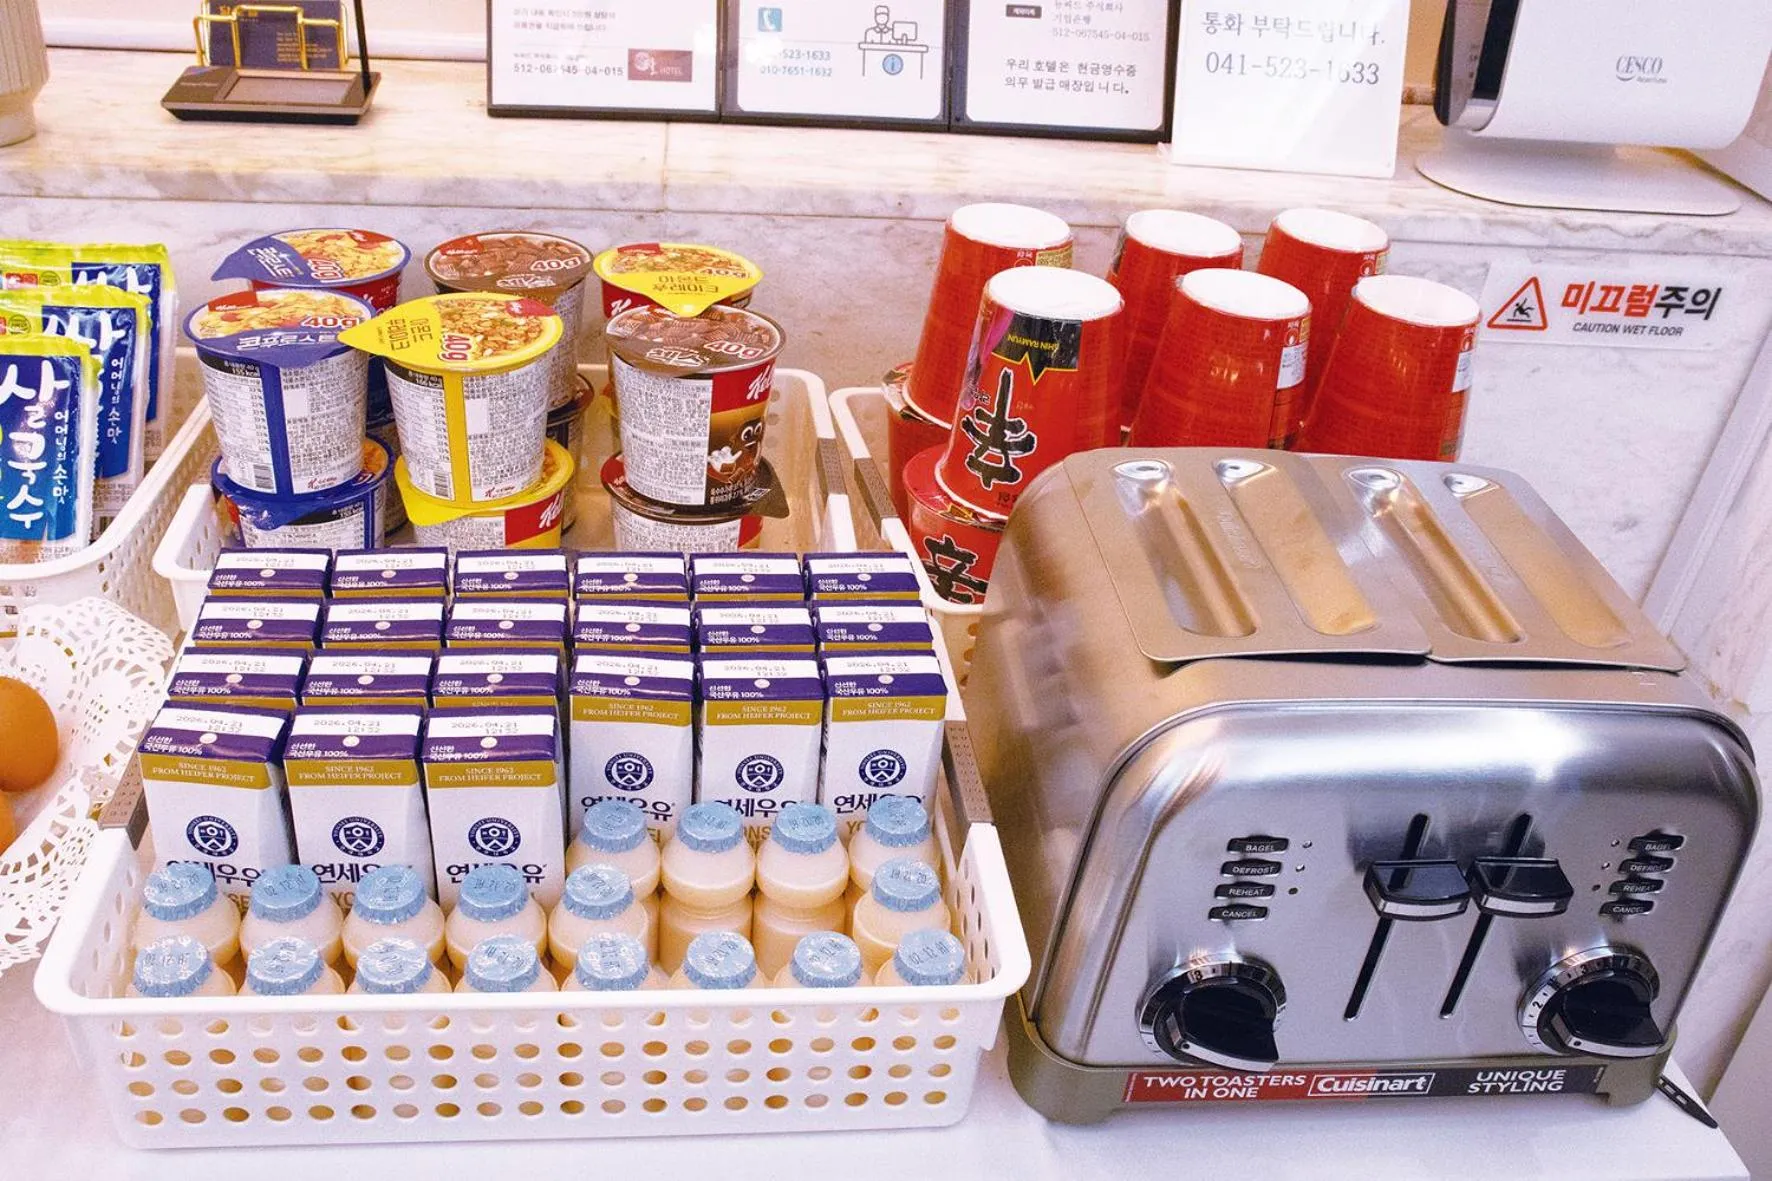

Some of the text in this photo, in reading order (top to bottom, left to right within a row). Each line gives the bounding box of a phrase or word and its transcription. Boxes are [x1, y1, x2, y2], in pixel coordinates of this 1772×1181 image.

[1202, 11, 1244, 36] 통화
[1006, 59, 1029, 71] 우리
[1033, 60, 1069, 73] 호텔은
[1560, 281, 1723, 320] 미끄럼주의
[1572, 321, 1684, 337] CAUTION WET FLOOR
[581, 796, 673, 823] 연유
[834, 792, 923, 817] 연세
[1245, 844, 1275, 852] BAGEL
[446, 861, 546, 885] 연유
[1233, 866, 1275, 874] DEFROST
[1229, 888, 1264, 896] REHEAT
[1222, 910, 1258, 918] CANCEL
[1143, 1074, 1306, 1088] TWO TOASTERS
[1476, 1069, 1567, 1082] UNIQUE
[1317, 1075, 1427, 1093] Cuisinart
[1467, 1081, 1565, 1094] STYLING
[1184, 1086, 1260, 1098] IN ONE
